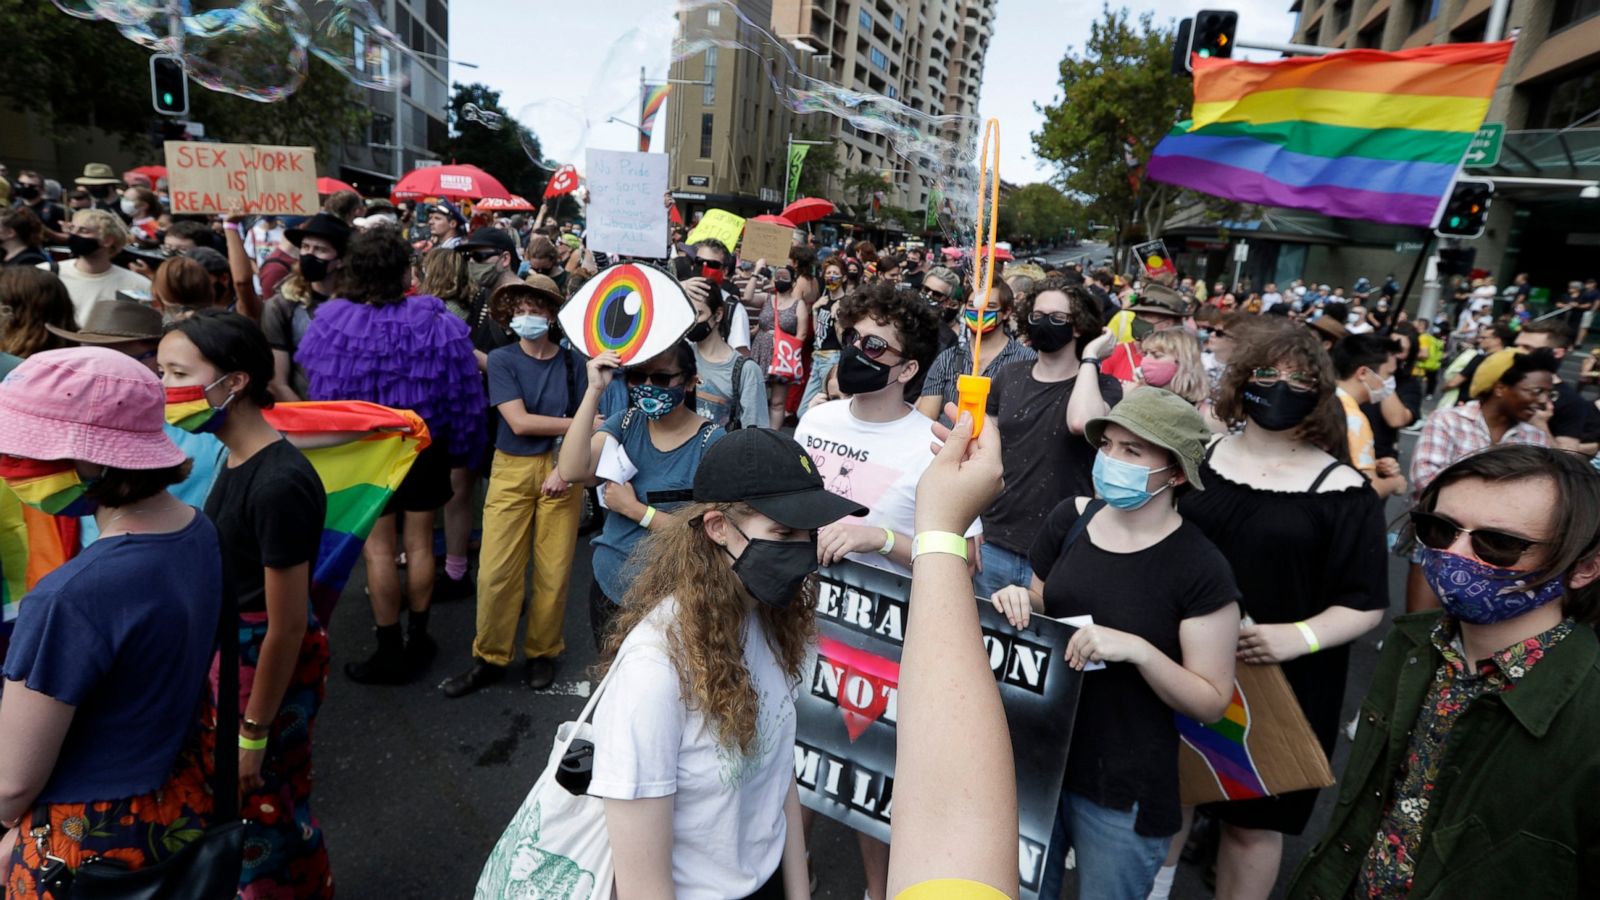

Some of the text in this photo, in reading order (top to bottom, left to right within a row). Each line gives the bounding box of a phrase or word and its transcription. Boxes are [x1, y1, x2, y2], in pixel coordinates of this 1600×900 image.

[176, 146, 304, 172] SEX WORK
[620, 159, 649, 177] Pride
[227, 171, 248, 191] IS
[441, 174, 472, 184] UNITED
[173, 191, 306, 213] REAL WORK
[807, 435, 870, 463] BOTTOMS
